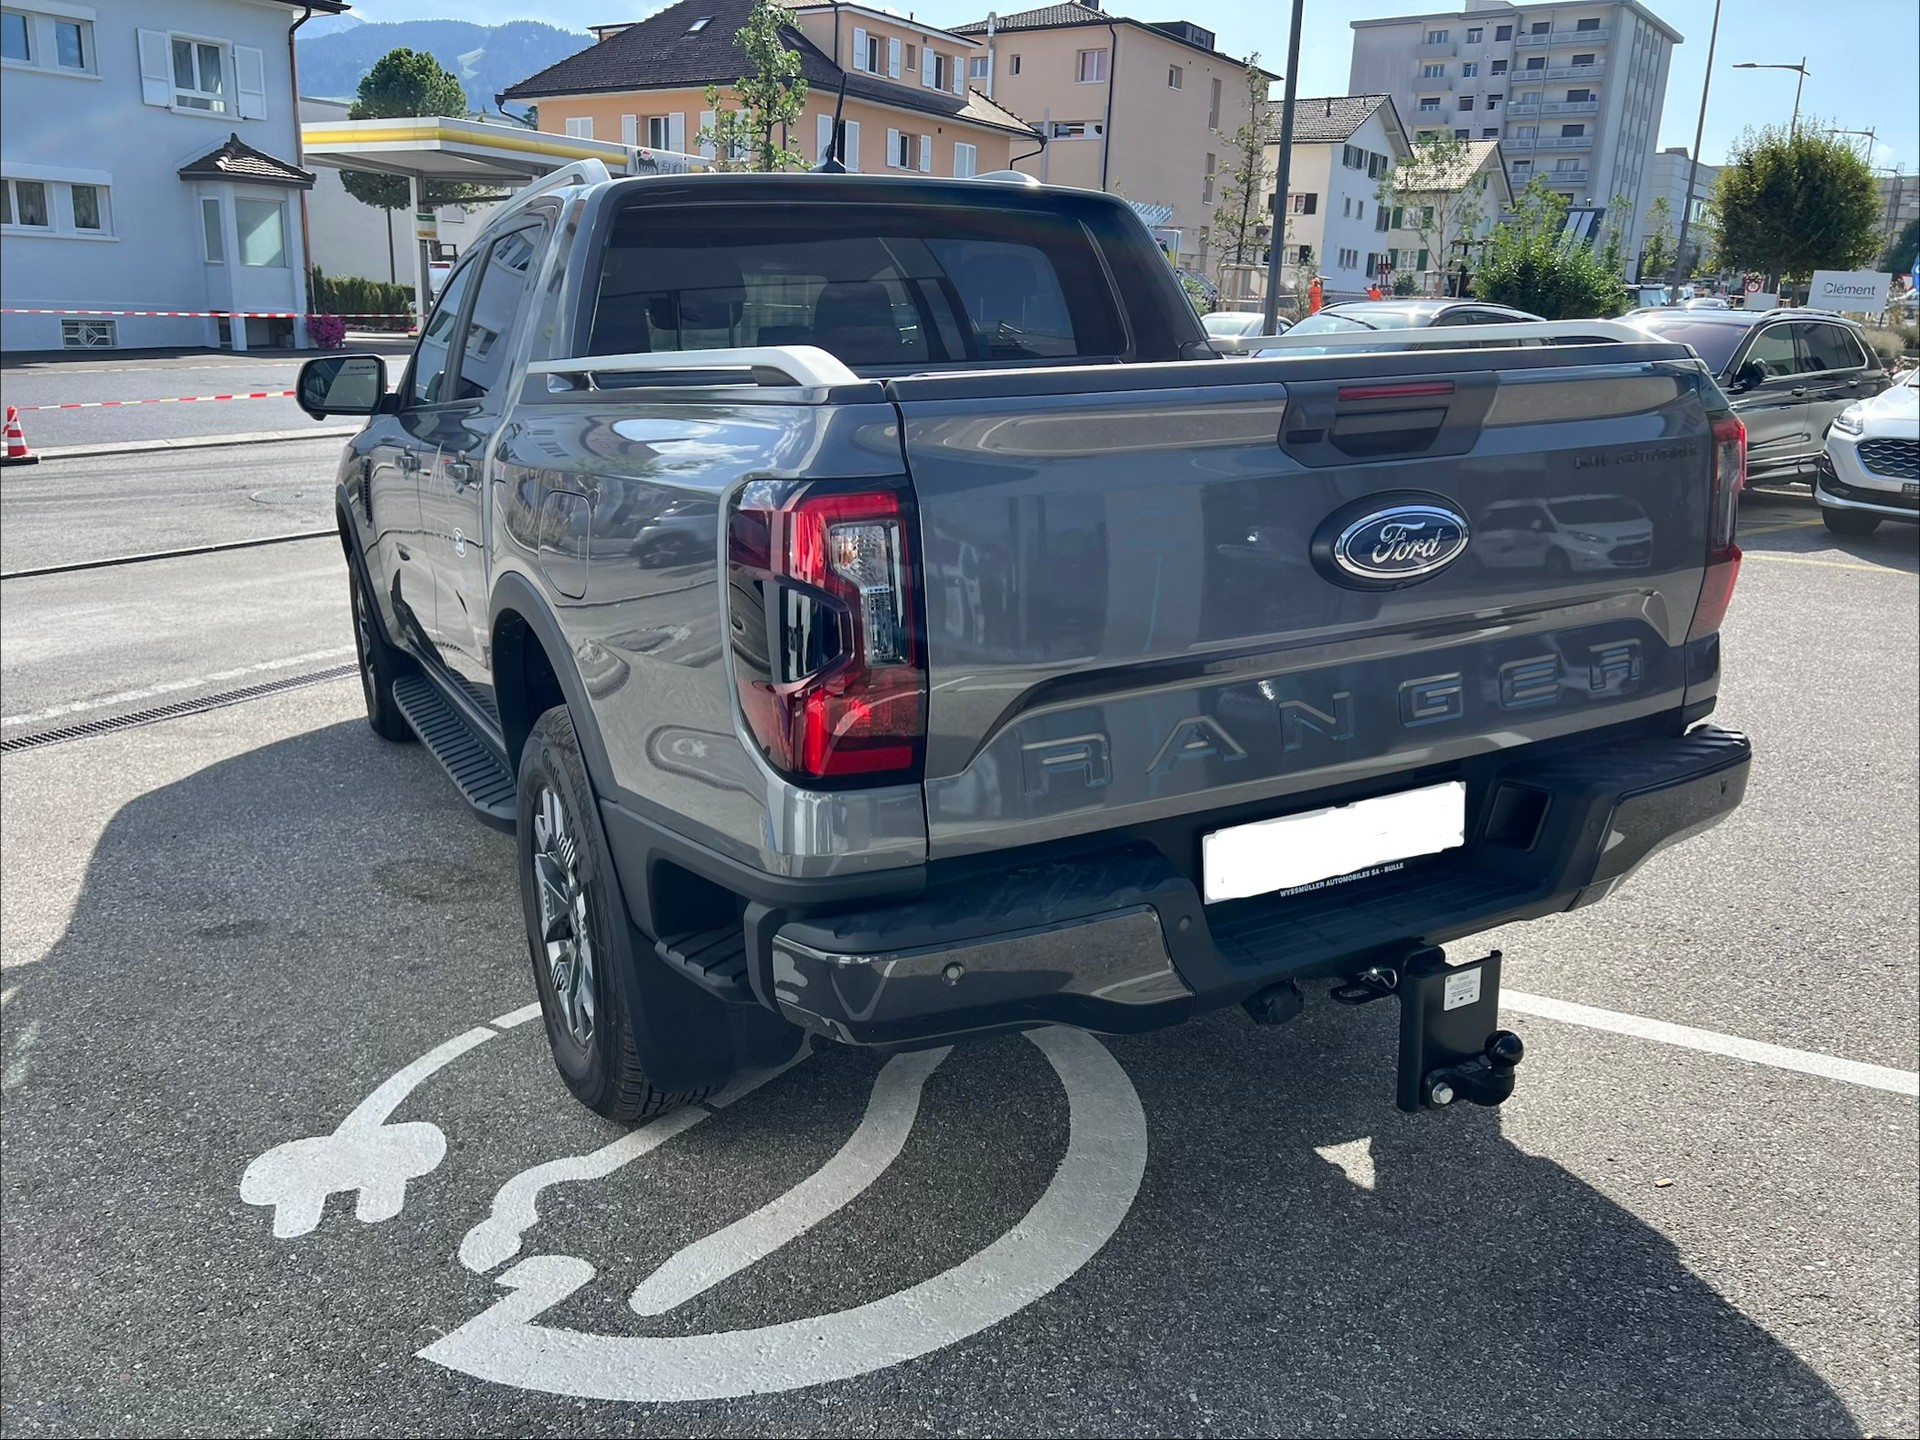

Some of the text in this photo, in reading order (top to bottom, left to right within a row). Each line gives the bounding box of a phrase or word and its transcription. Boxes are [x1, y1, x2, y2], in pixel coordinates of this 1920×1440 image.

[1824, 282, 1876, 296] Clément
[1372, 521, 1443, 564] Ford
[1021, 638, 1644, 799] RANGER
[1279, 881, 1325, 898] WYSSMÜLLER
[1325, 870, 1371, 887] AUTOMOBILES
[1371, 868, 1380, 876] SA
[1384, 862, 1405, 874] BULLE
